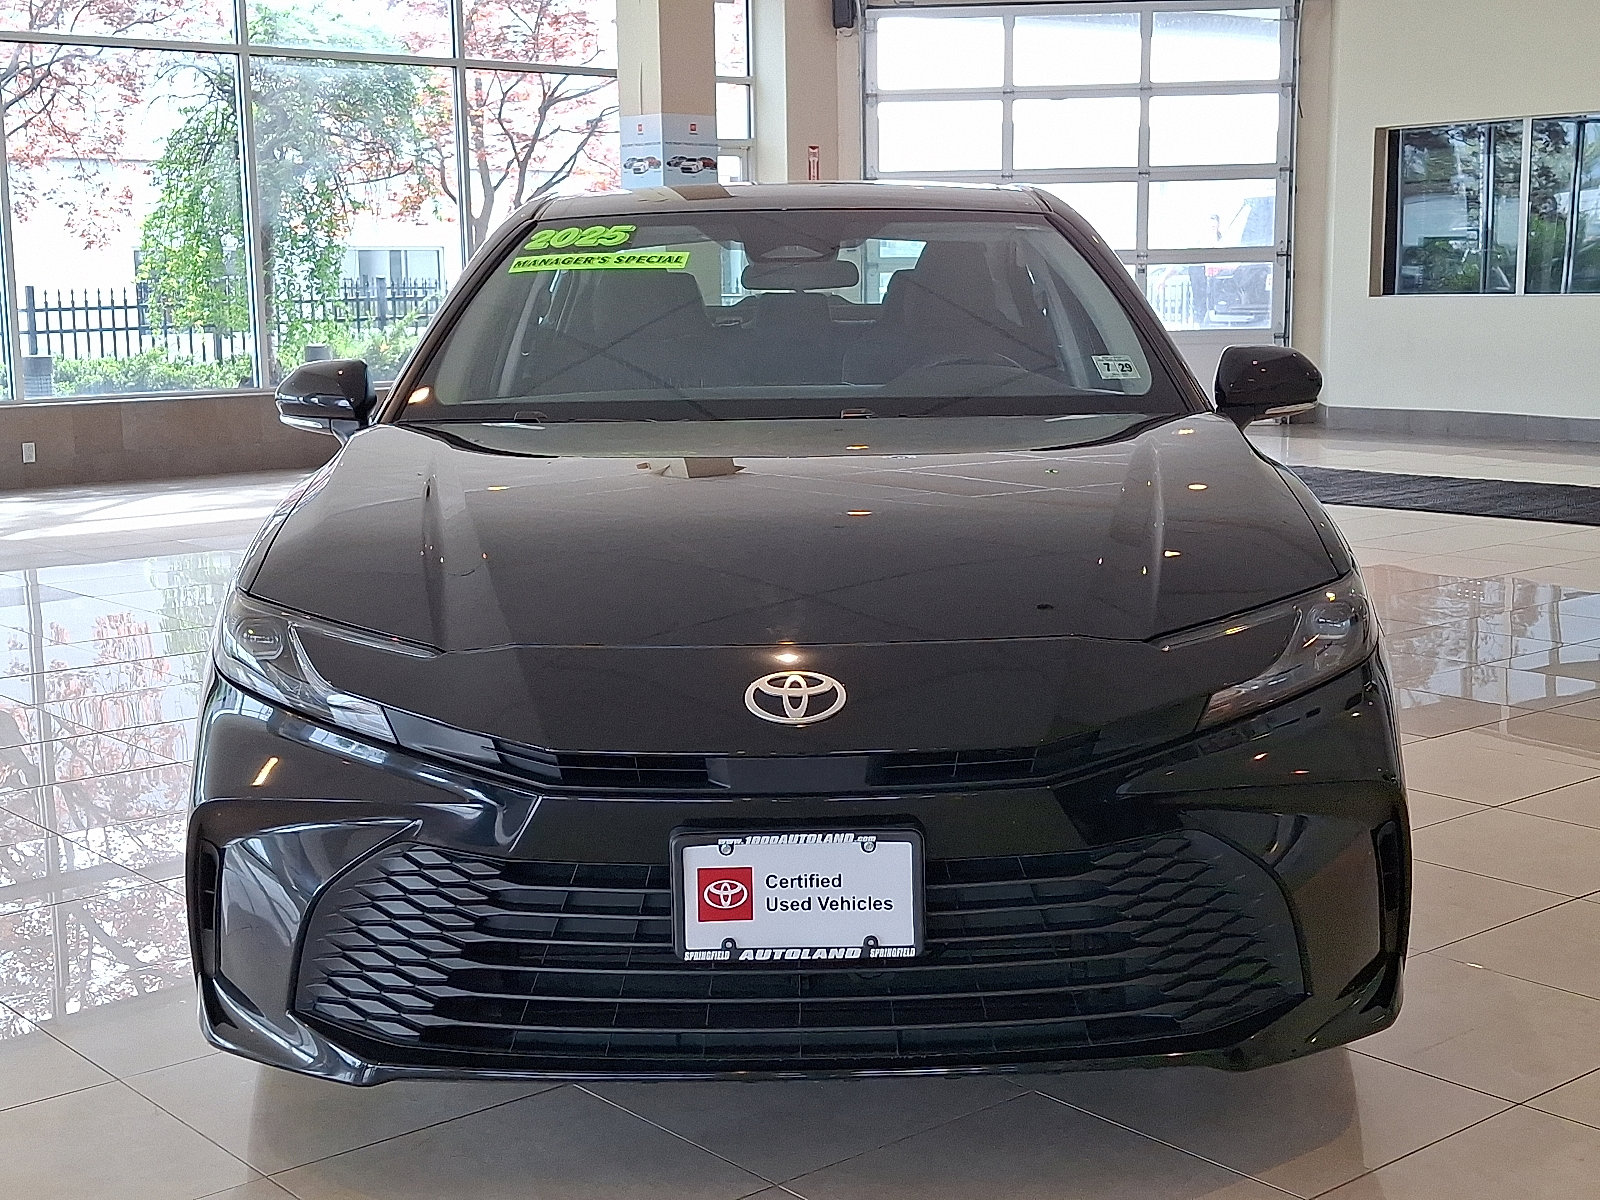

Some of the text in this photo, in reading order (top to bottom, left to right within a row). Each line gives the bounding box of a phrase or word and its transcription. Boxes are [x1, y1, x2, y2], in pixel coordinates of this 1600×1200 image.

[524, 225, 636, 250] 2025
[513, 255, 683, 268] MANAGER'S SPECIAL
[1103, 362, 1133, 372] 7 29
[765, 873, 842, 889] Certified
[766, 896, 894, 912] Used Vehicles
[684, 947, 916, 961] SPRINGFIELD AUTOLAND SPRINGFIELD
